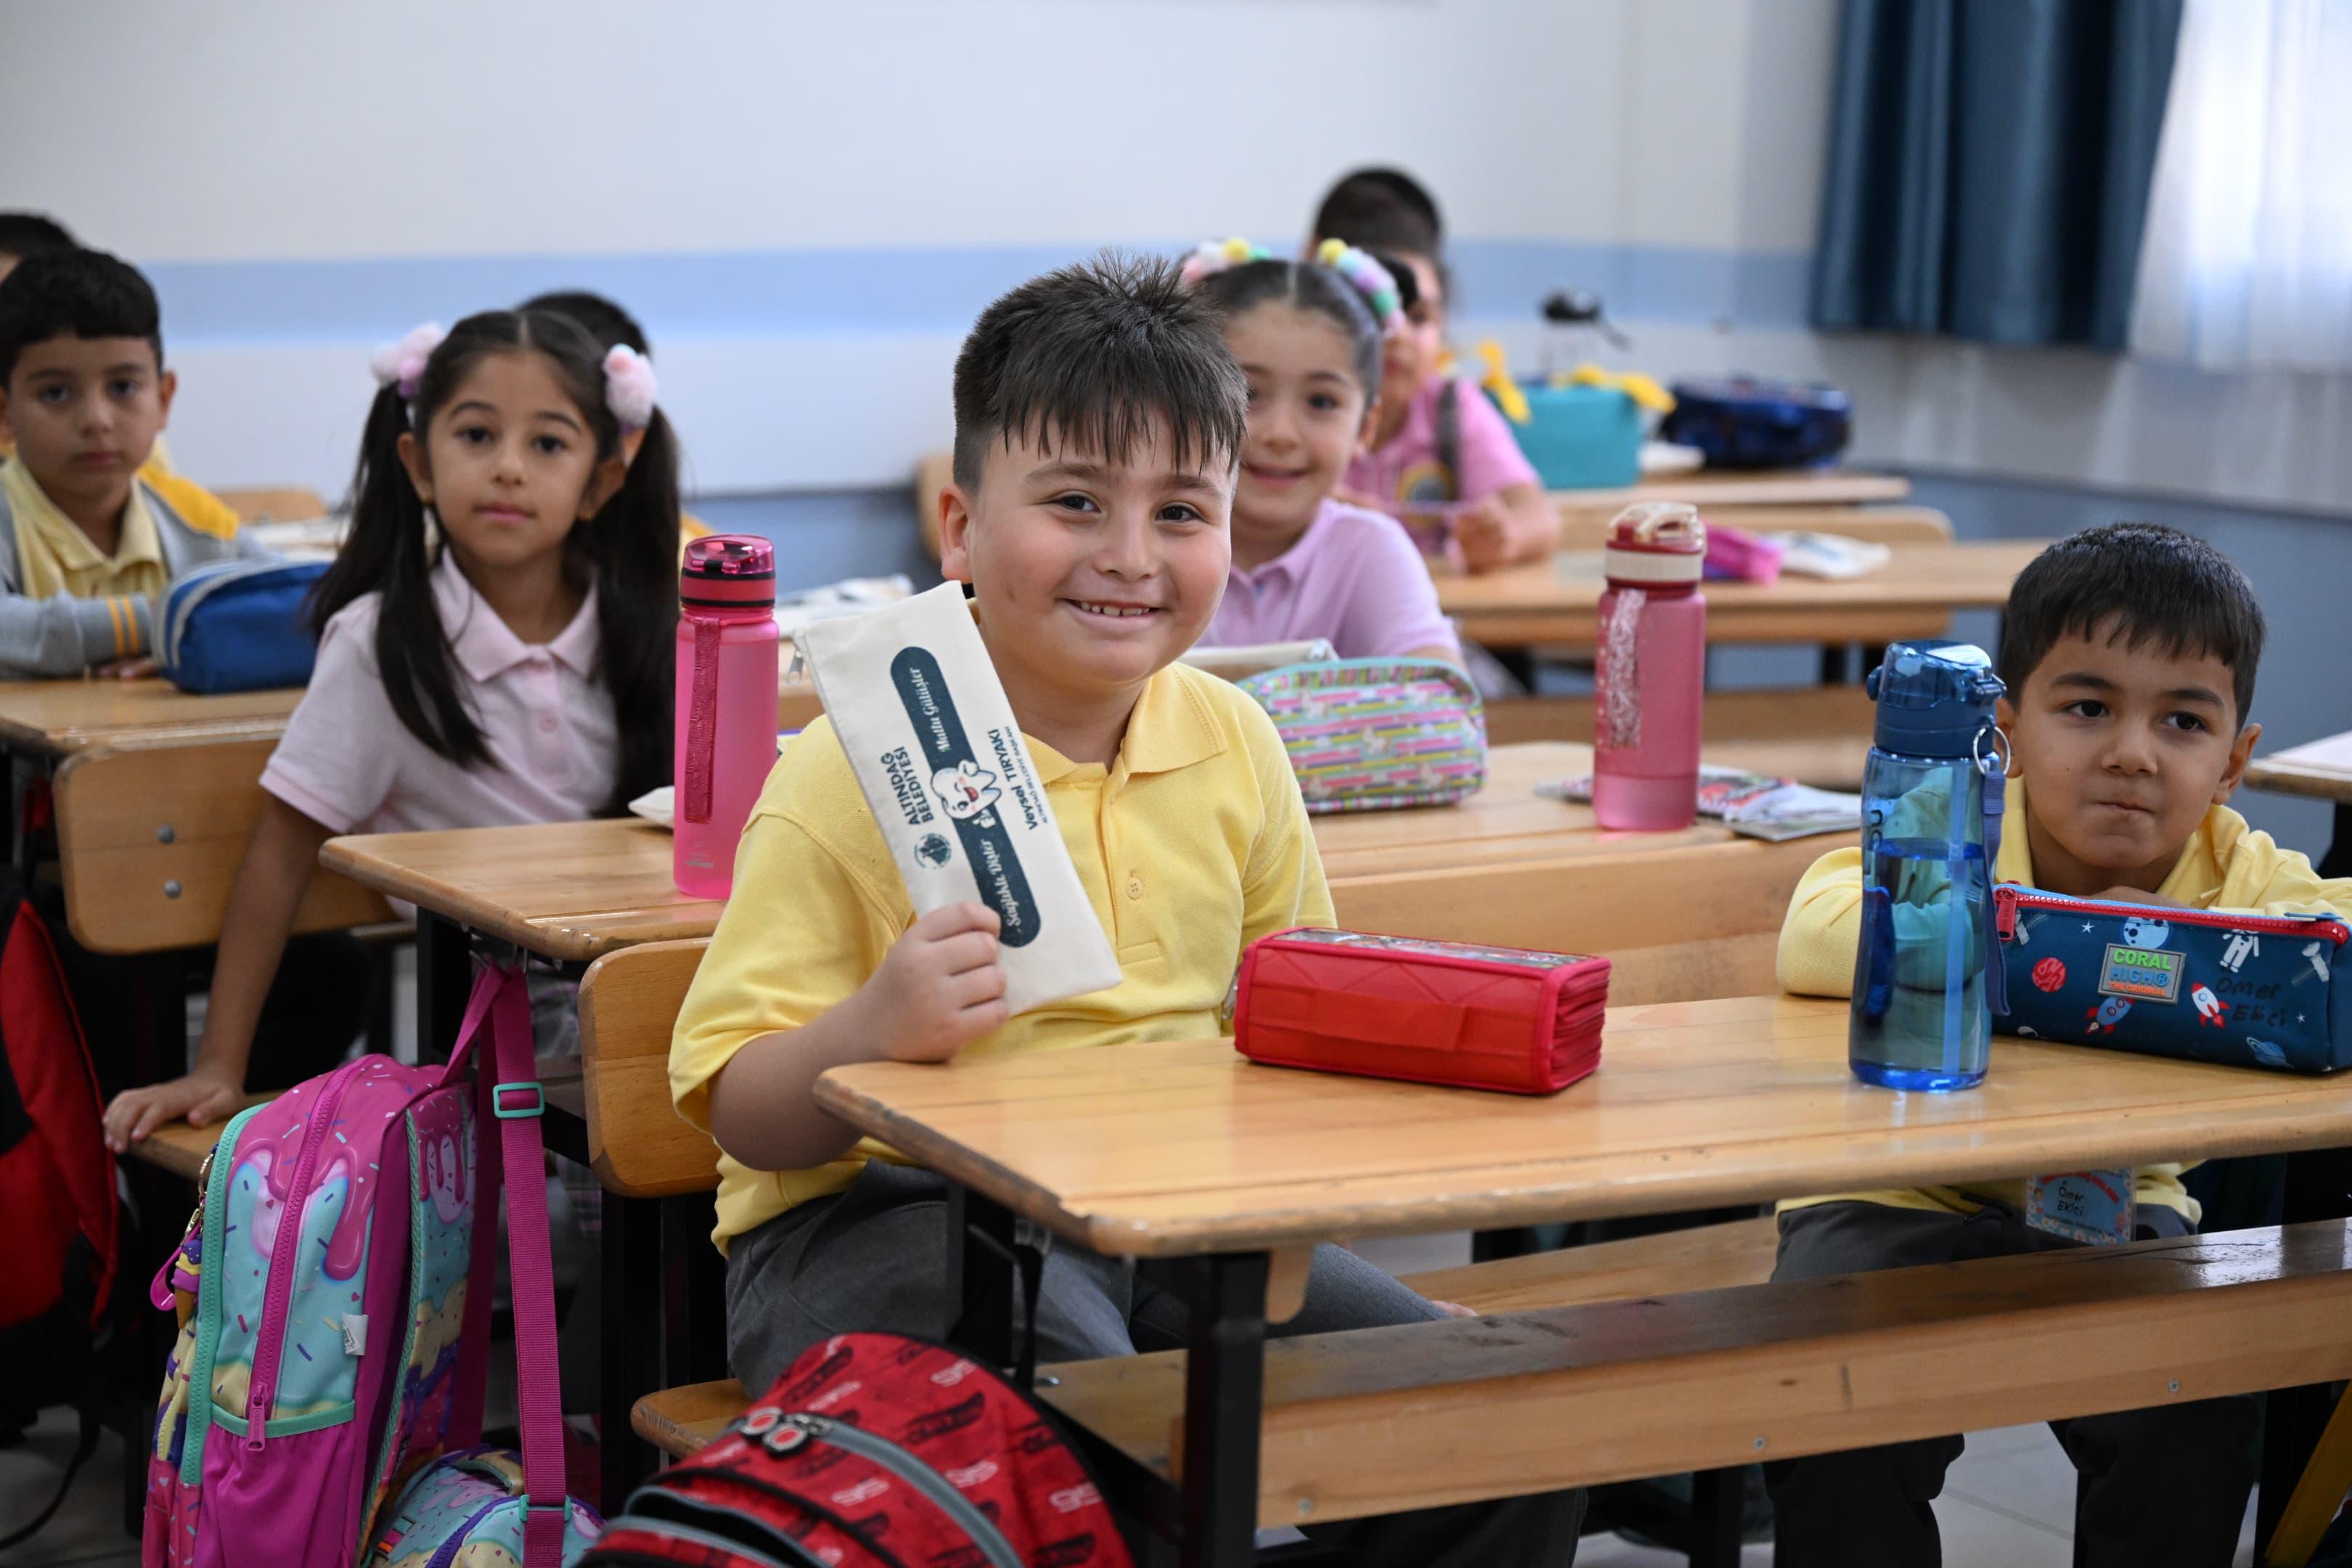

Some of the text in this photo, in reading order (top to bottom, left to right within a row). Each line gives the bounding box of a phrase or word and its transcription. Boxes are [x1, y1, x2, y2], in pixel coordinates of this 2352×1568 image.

[1011, 785, 1037, 830] Veysel
[2113, 948, 2172, 971] CORAL
[2128, 984, 2166, 997] ORIGINAL
